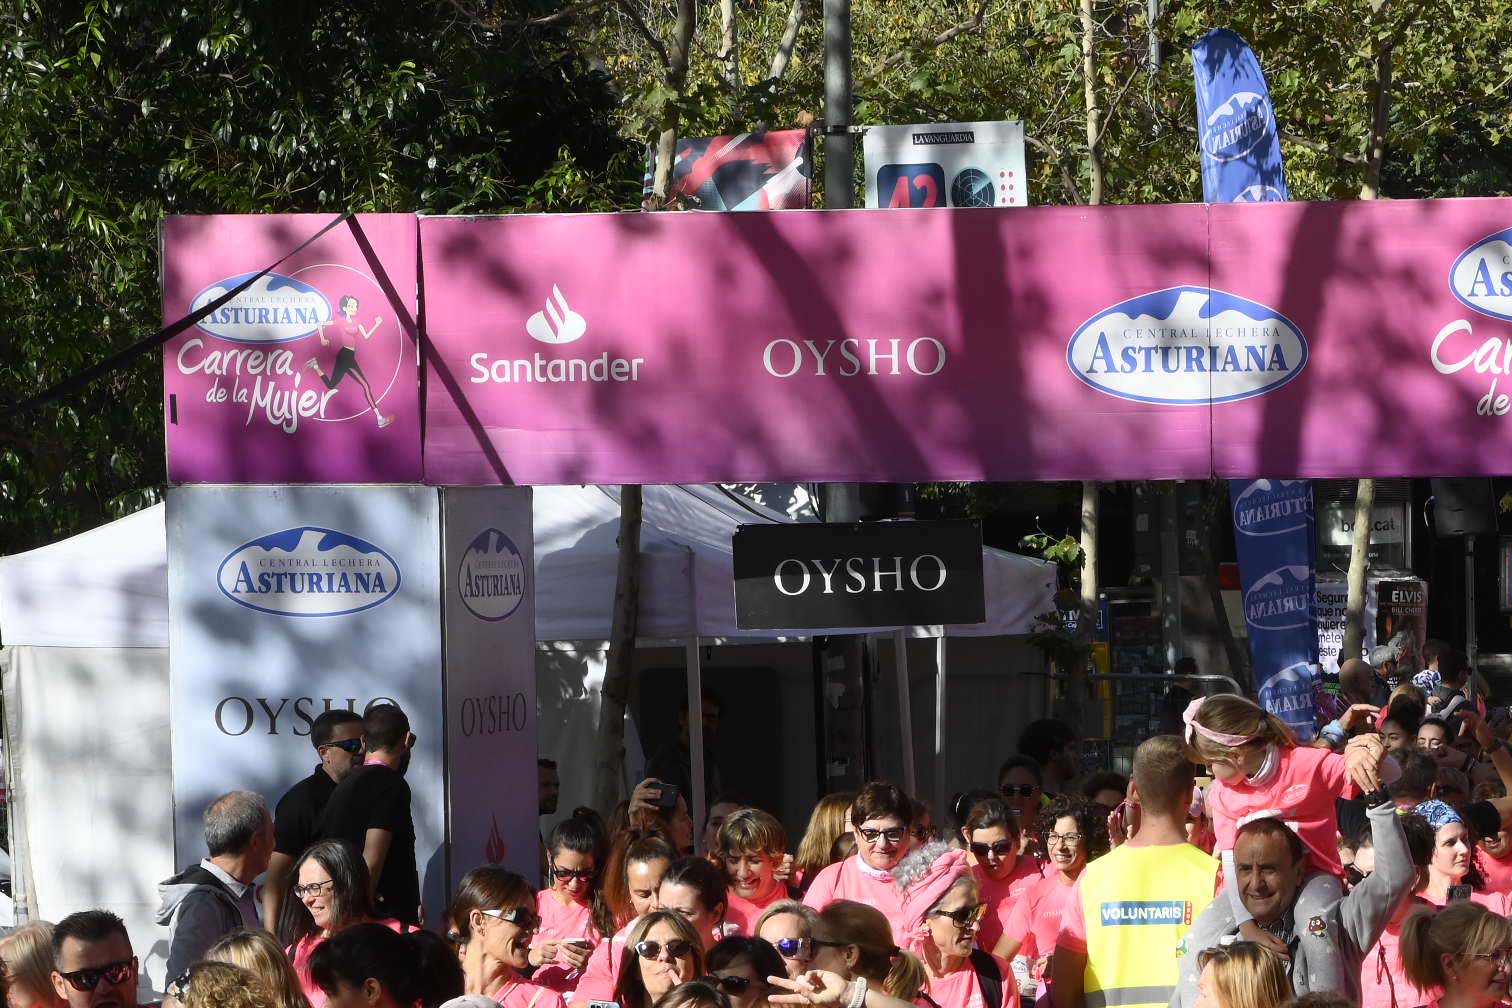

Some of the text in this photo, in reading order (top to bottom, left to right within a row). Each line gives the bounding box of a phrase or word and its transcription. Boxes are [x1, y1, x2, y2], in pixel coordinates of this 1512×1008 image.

[914, 132, 974, 144] LA VANGUARDIA
[200, 298, 321, 325] ASTURIANA
[227, 296, 266, 304] ENTRAL
[1123, 326, 1281, 340] CENTRAL LECHERA
[176, 338, 295, 377] Carrera
[470, 351, 645, 385] Santander
[762, 336, 947, 378] OYSHO
[1085, 332, 1289, 376] ASTURIANA
[205, 372, 340, 435] de la Mujer
[1476, 377, 1511, 417] de
[232, 560, 389, 595] ASTURIANA
[259, 557, 381, 569] CENTRAL LECHERA
[463, 561, 523, 599] ASTURIANA
[773, 554, 948, 596] OYSHO
[1391, 590, 1423, 603] ELVIS
[214, 696, 402, 737] OYS
[460, 692, 527, 737] OYSHO
[1102, 906, 1182, 920] VOLUNTARIS
